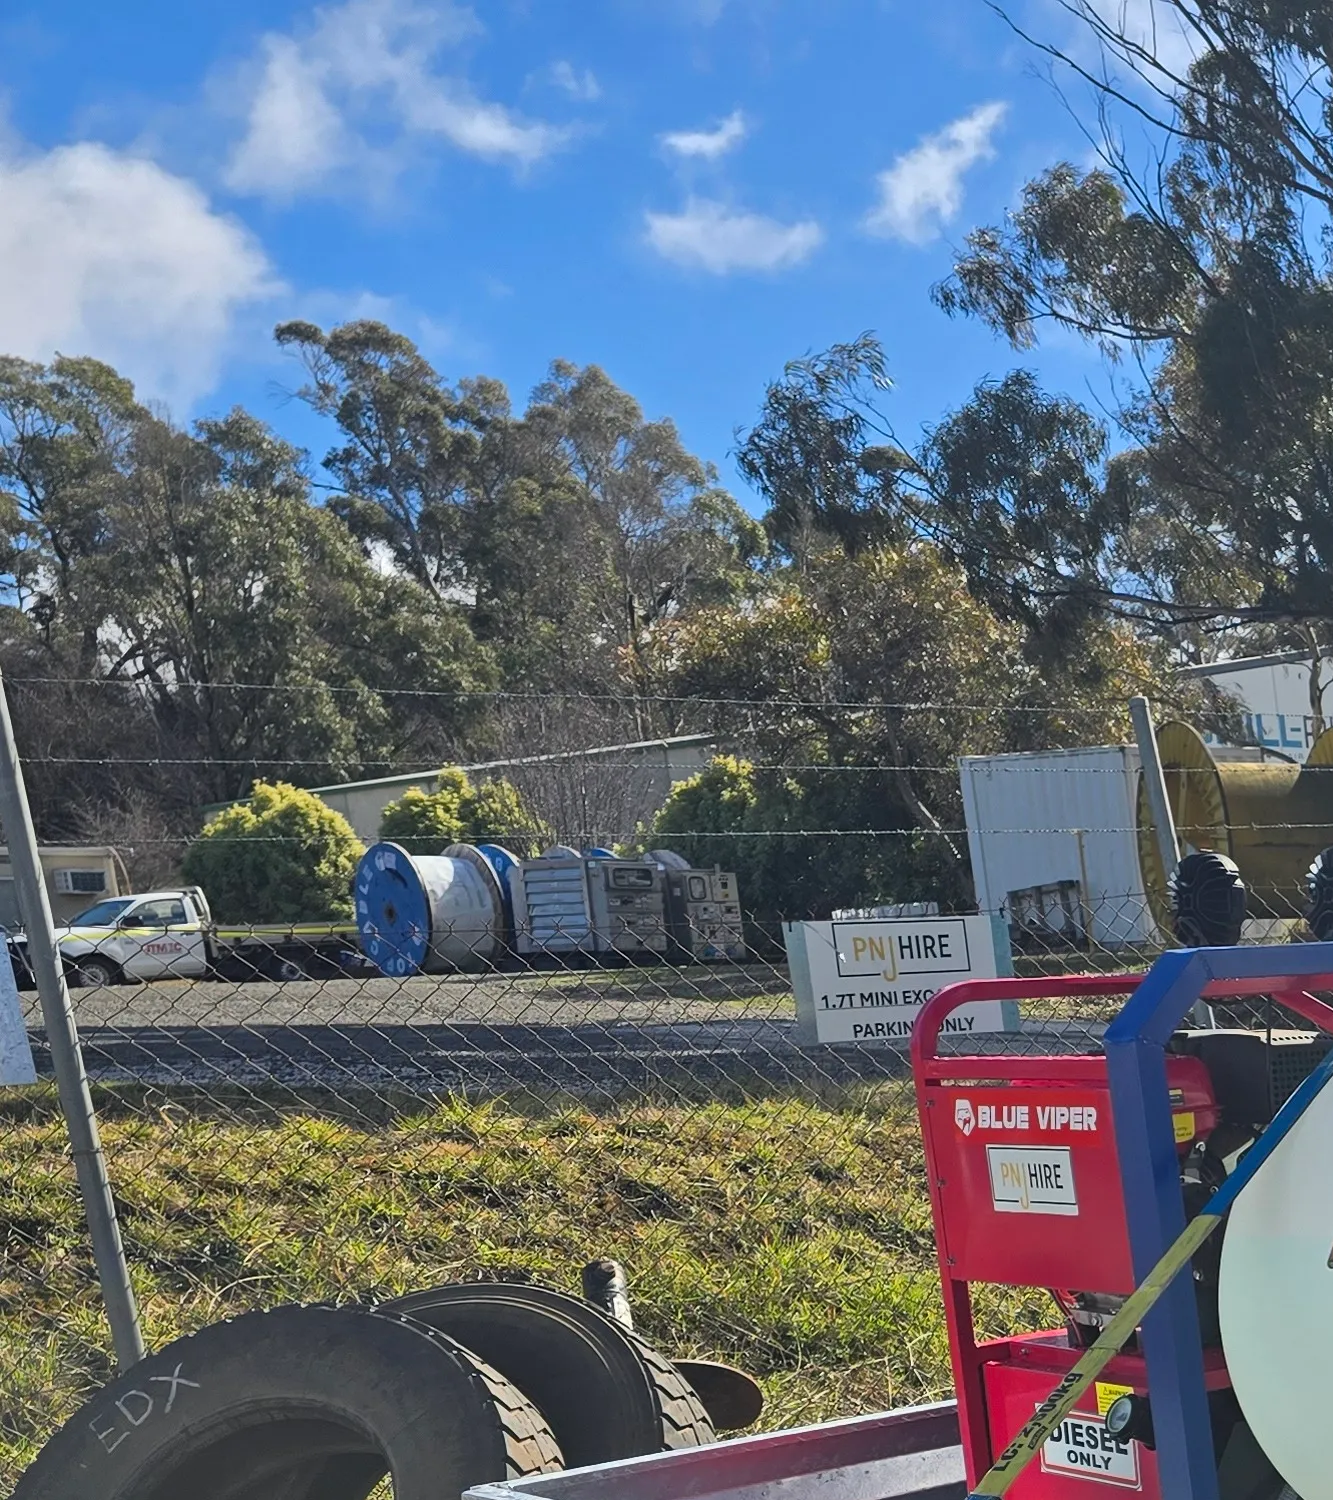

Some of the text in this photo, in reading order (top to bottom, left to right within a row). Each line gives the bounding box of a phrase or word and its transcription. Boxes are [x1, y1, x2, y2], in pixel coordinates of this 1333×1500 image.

[852, 934, 952, 982] PNJ HIRE
[821, 993, 858, 1009] 1.7T
[860, 990, 898, 1007] MINI
[852, 1019, 914, 1039] PARKIN
[977, 1105, 1097, 1131] BLUE VIPER
[1000, 1161, 1064, 1210] PNJ HIRE
[91, 1362, 202, 1455] EDX
[1066, 1450, 1112, 1470] ONLY
